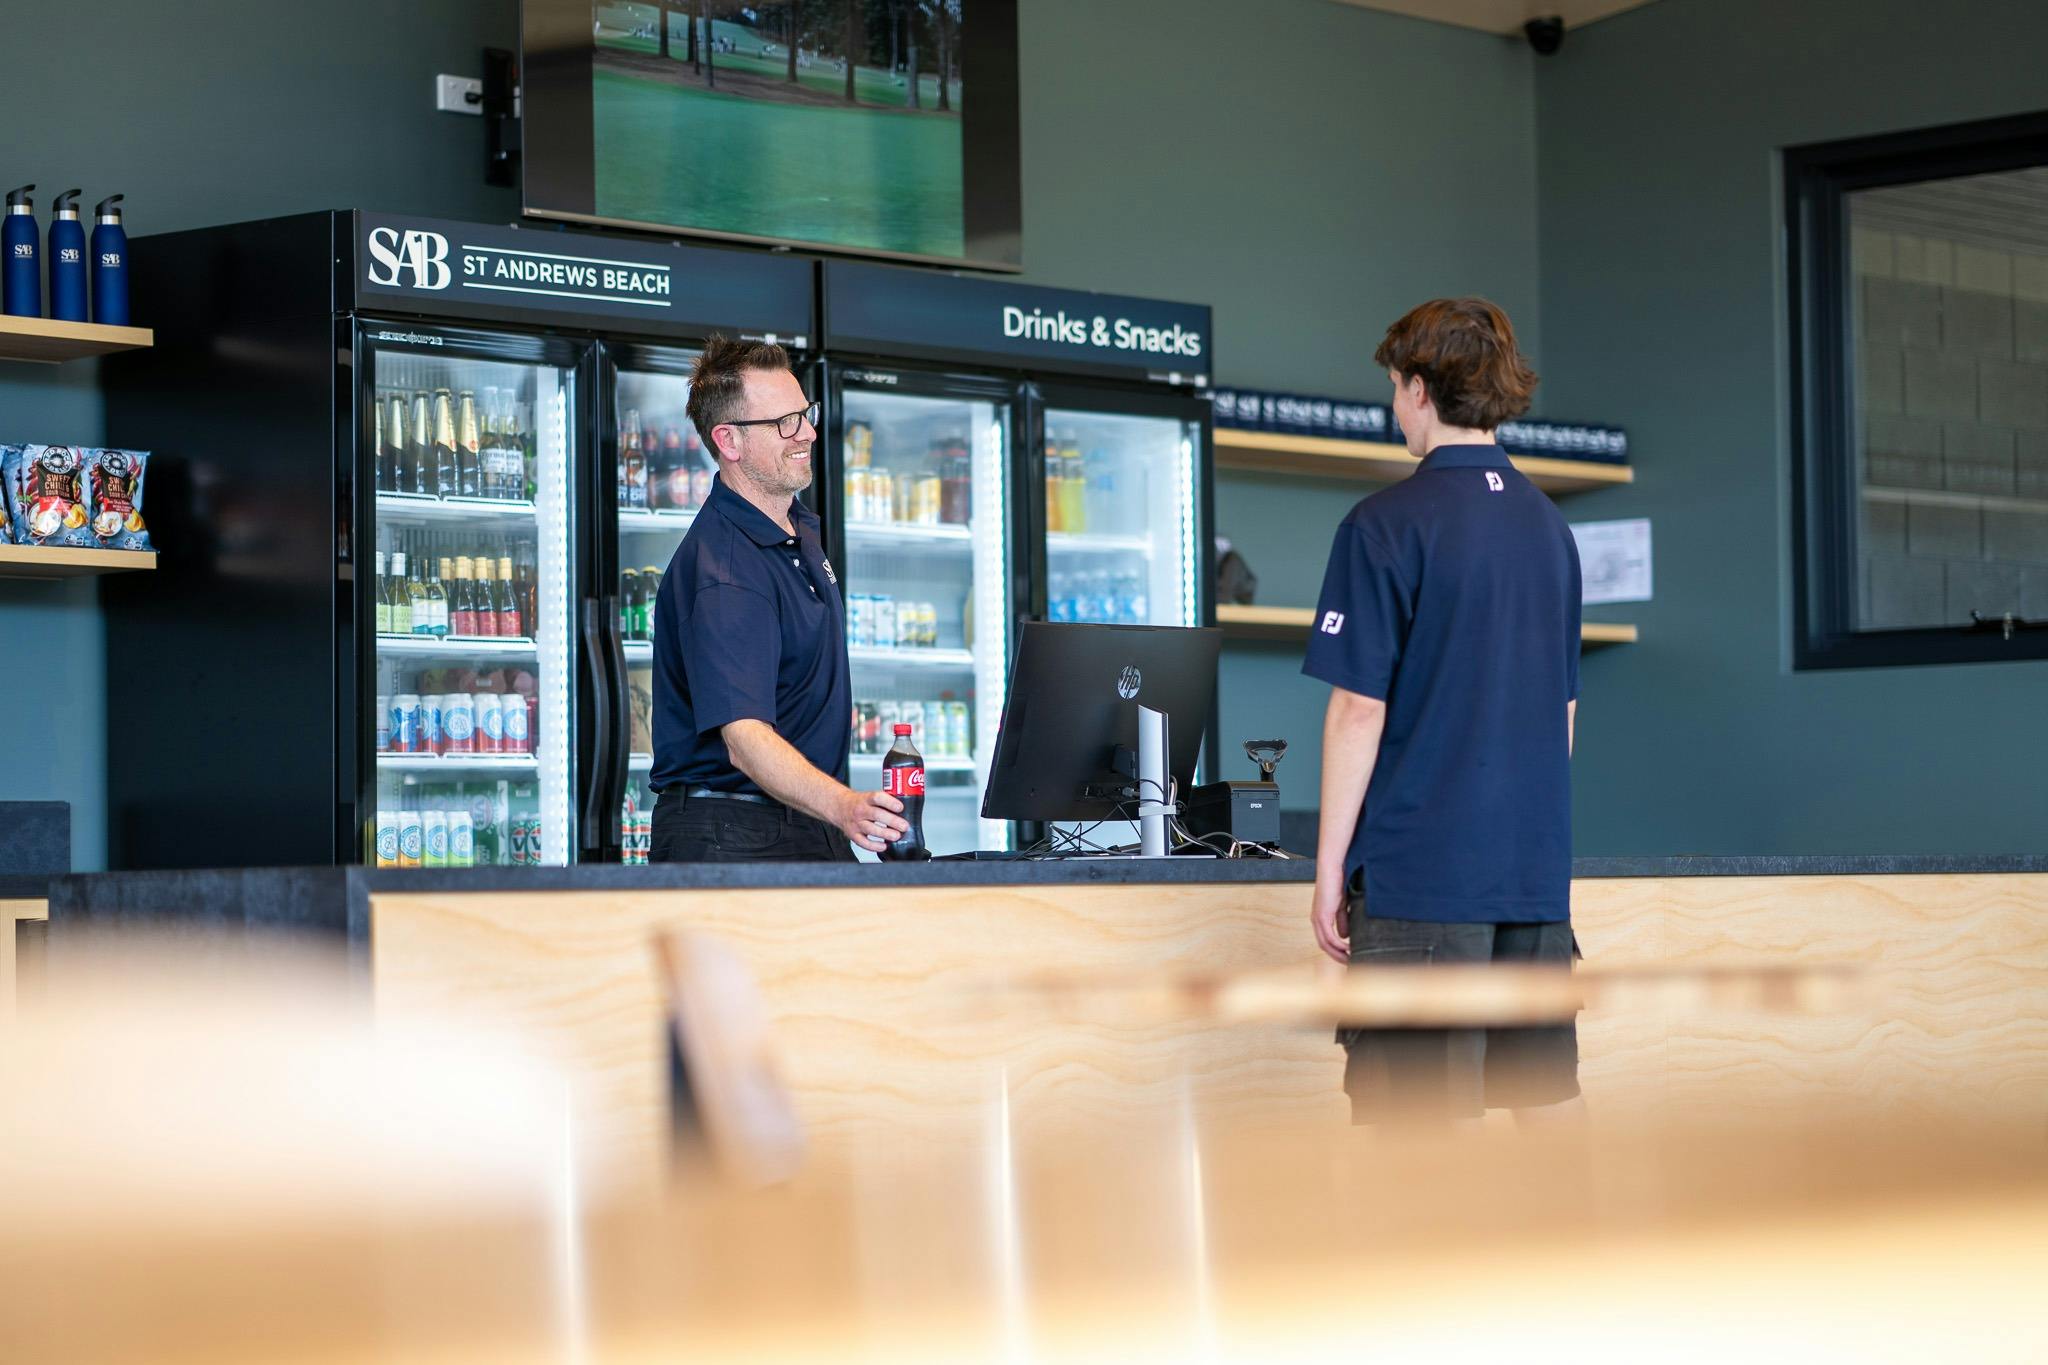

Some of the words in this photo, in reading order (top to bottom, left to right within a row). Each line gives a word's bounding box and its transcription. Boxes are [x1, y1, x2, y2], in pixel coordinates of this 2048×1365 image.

[14, 244, 33, 255] SAB
[60, 248, 79, 260] SAB
[102, 253, 120, 265] SAB
[368, 227, 451, 290] SAB
[463, 255, 489, 276] ST
[494, 258, 598, 288] ANDREWS
[603, 269, 671, 295] BEACH
[1003, 306, 1087, 345] Drinks
[1090, 315, 1111, 347] &
[1113, 318, 1202, 357] Snacks
[1485, 471, 1504, 491] FJ
[1320, 610, 1345, 635] FJ
